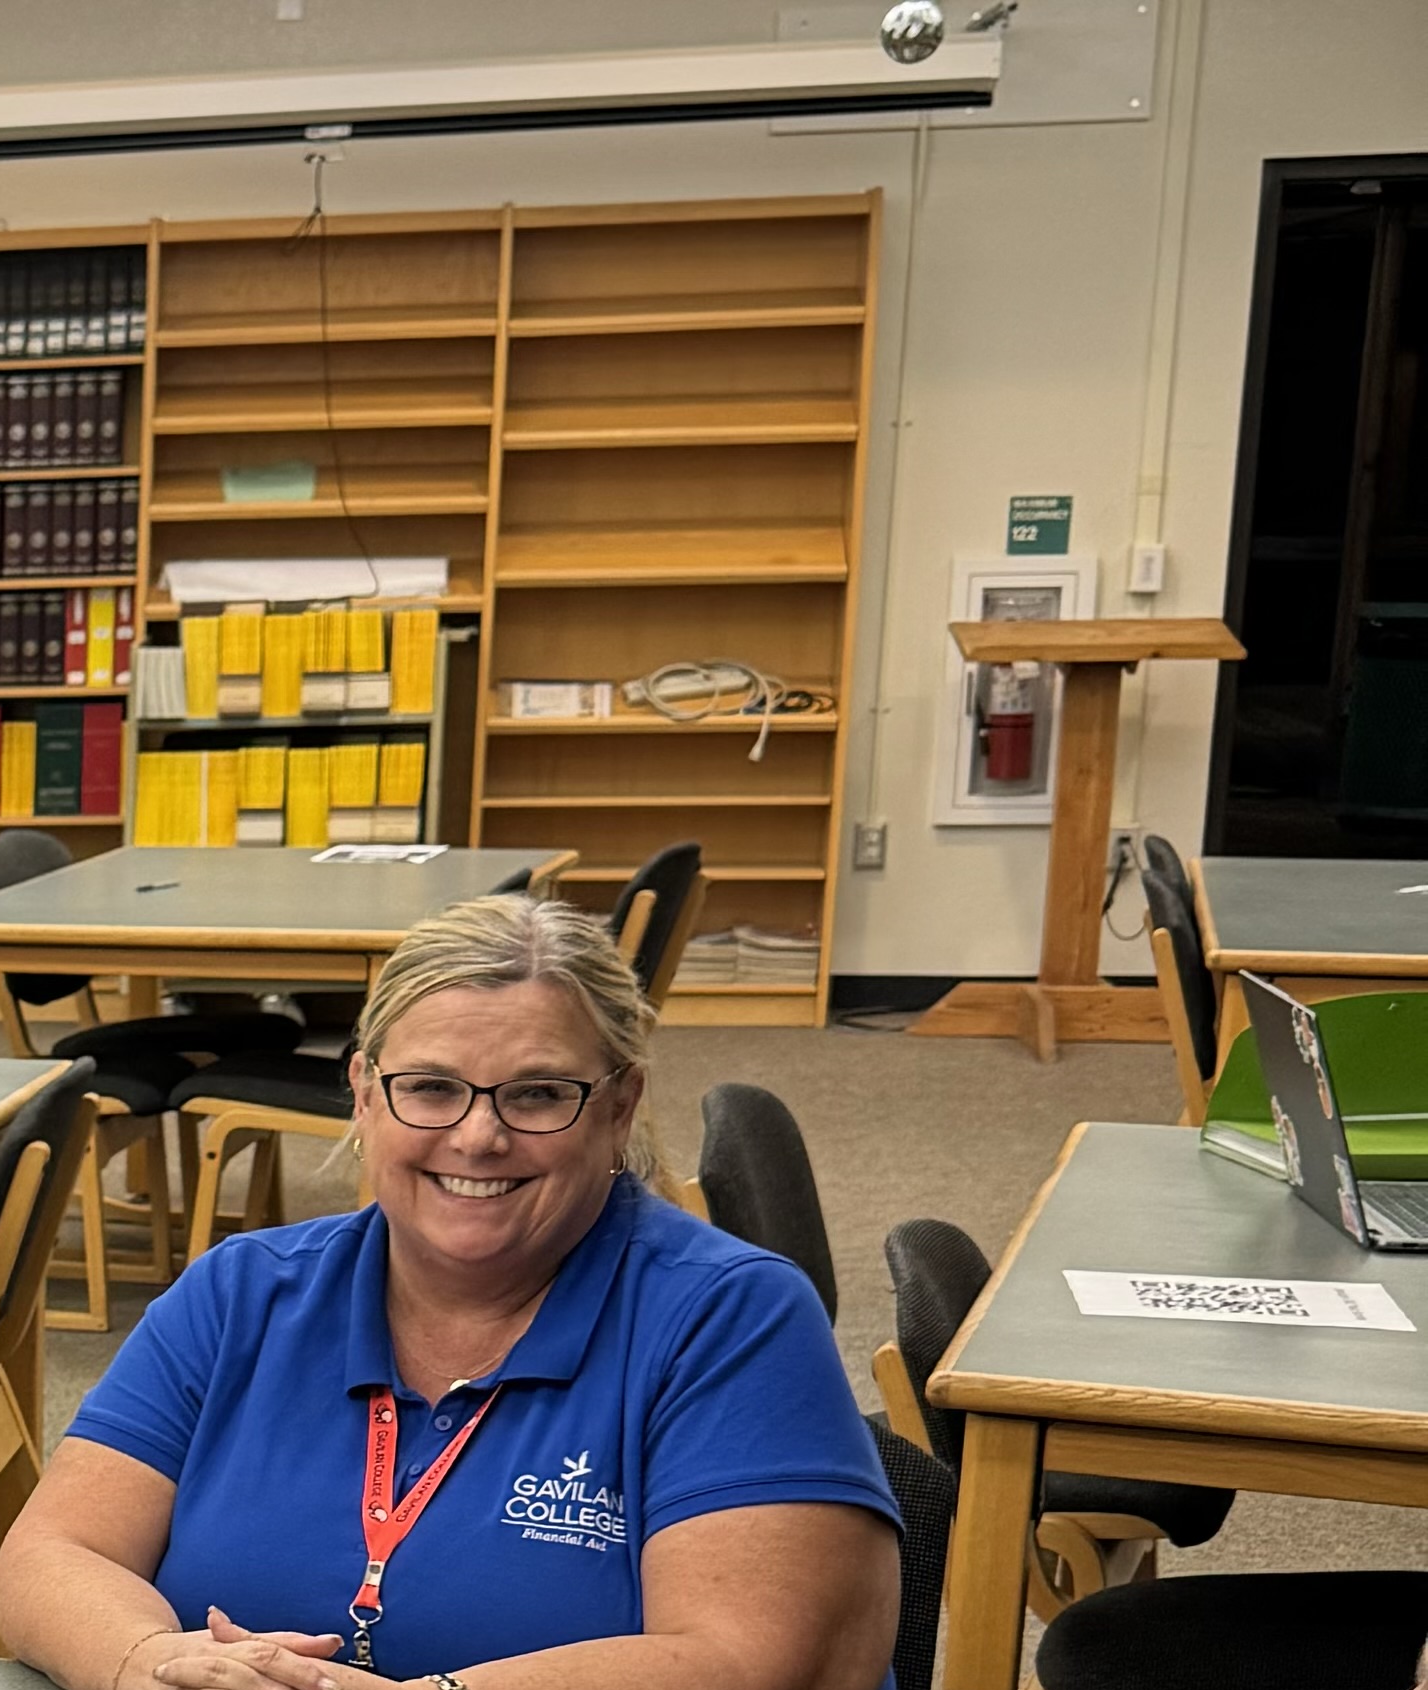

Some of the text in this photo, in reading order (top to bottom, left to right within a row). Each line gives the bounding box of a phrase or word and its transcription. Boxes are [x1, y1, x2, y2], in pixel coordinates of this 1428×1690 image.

[513, 1474, 624, 1514] GAVILAN
[505, 1496, 626, 1536] COLLEGE
[521, 1528, 584, 1546] Financial
